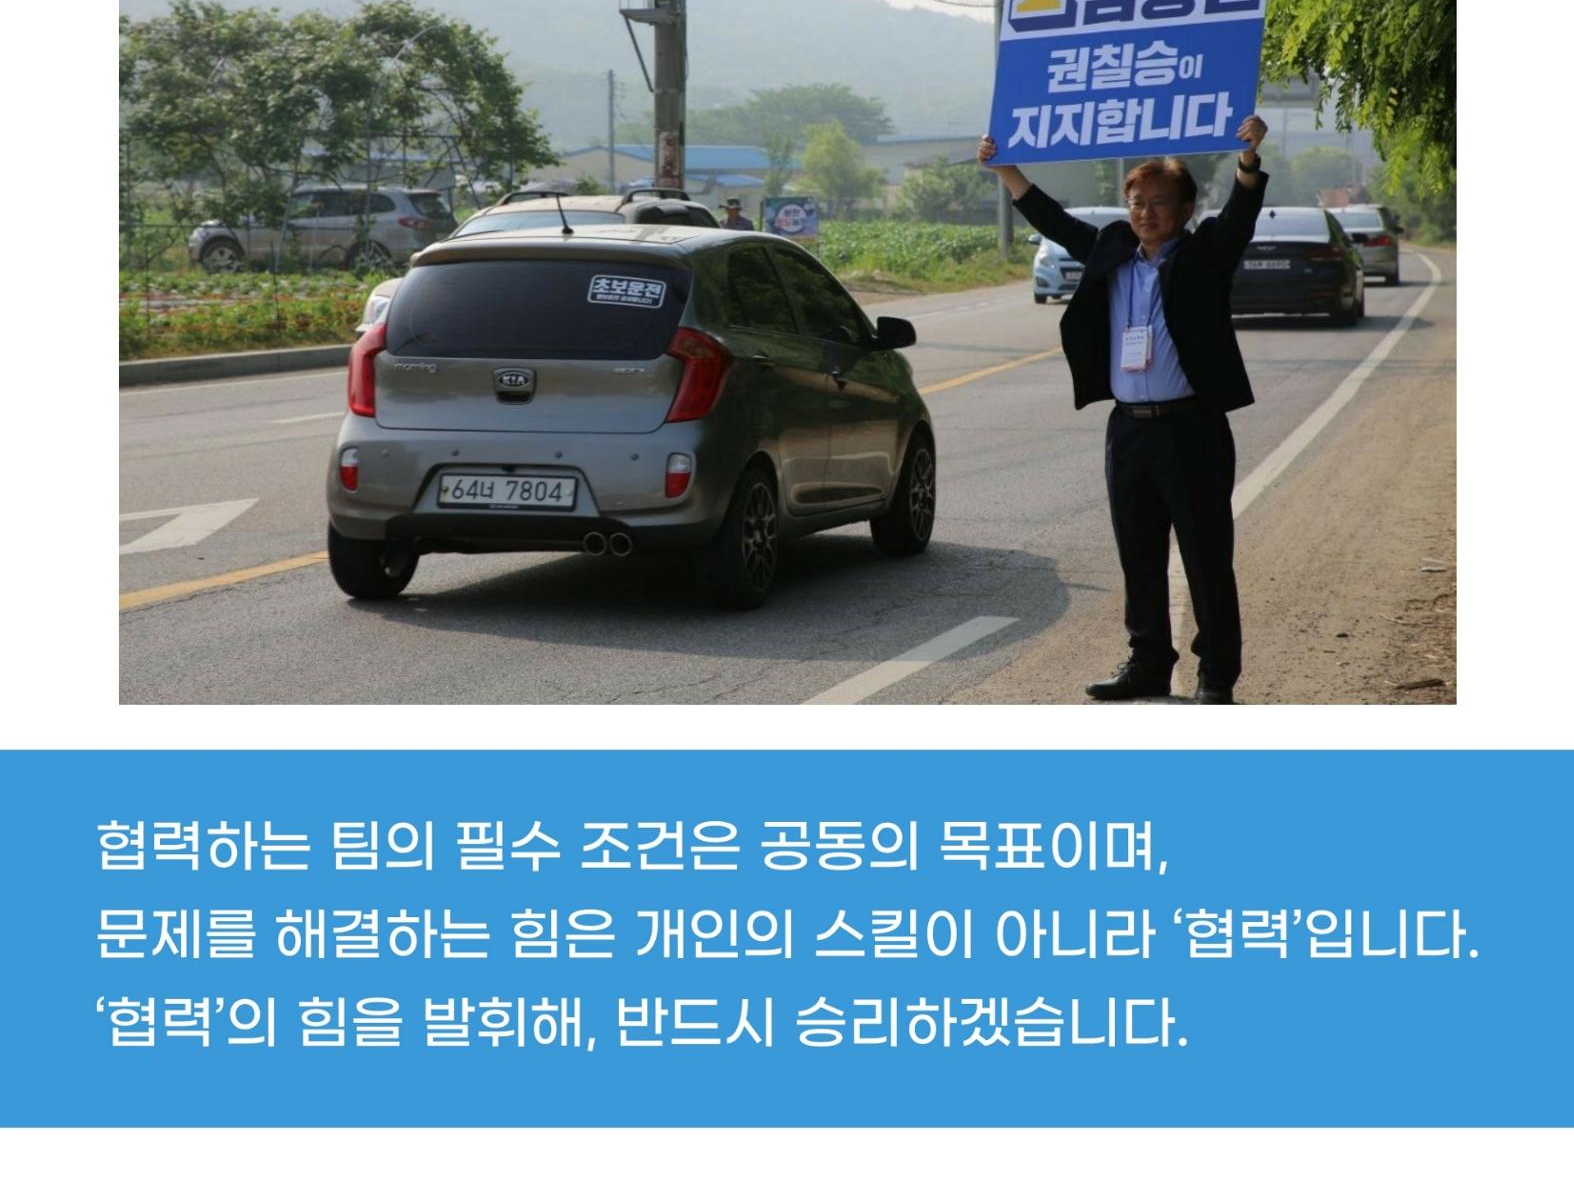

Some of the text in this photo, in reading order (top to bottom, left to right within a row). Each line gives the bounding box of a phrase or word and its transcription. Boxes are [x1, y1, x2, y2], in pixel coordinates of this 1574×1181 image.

[1048, 40, 1203, 93] 권칠승이
[1008, 91, 1233, 149] 지지합니다
[592, 278, 662, 298] 초보운전
[502, 374, 526, 386] KIA
[451, 478, 563, 501] 64너 7804
